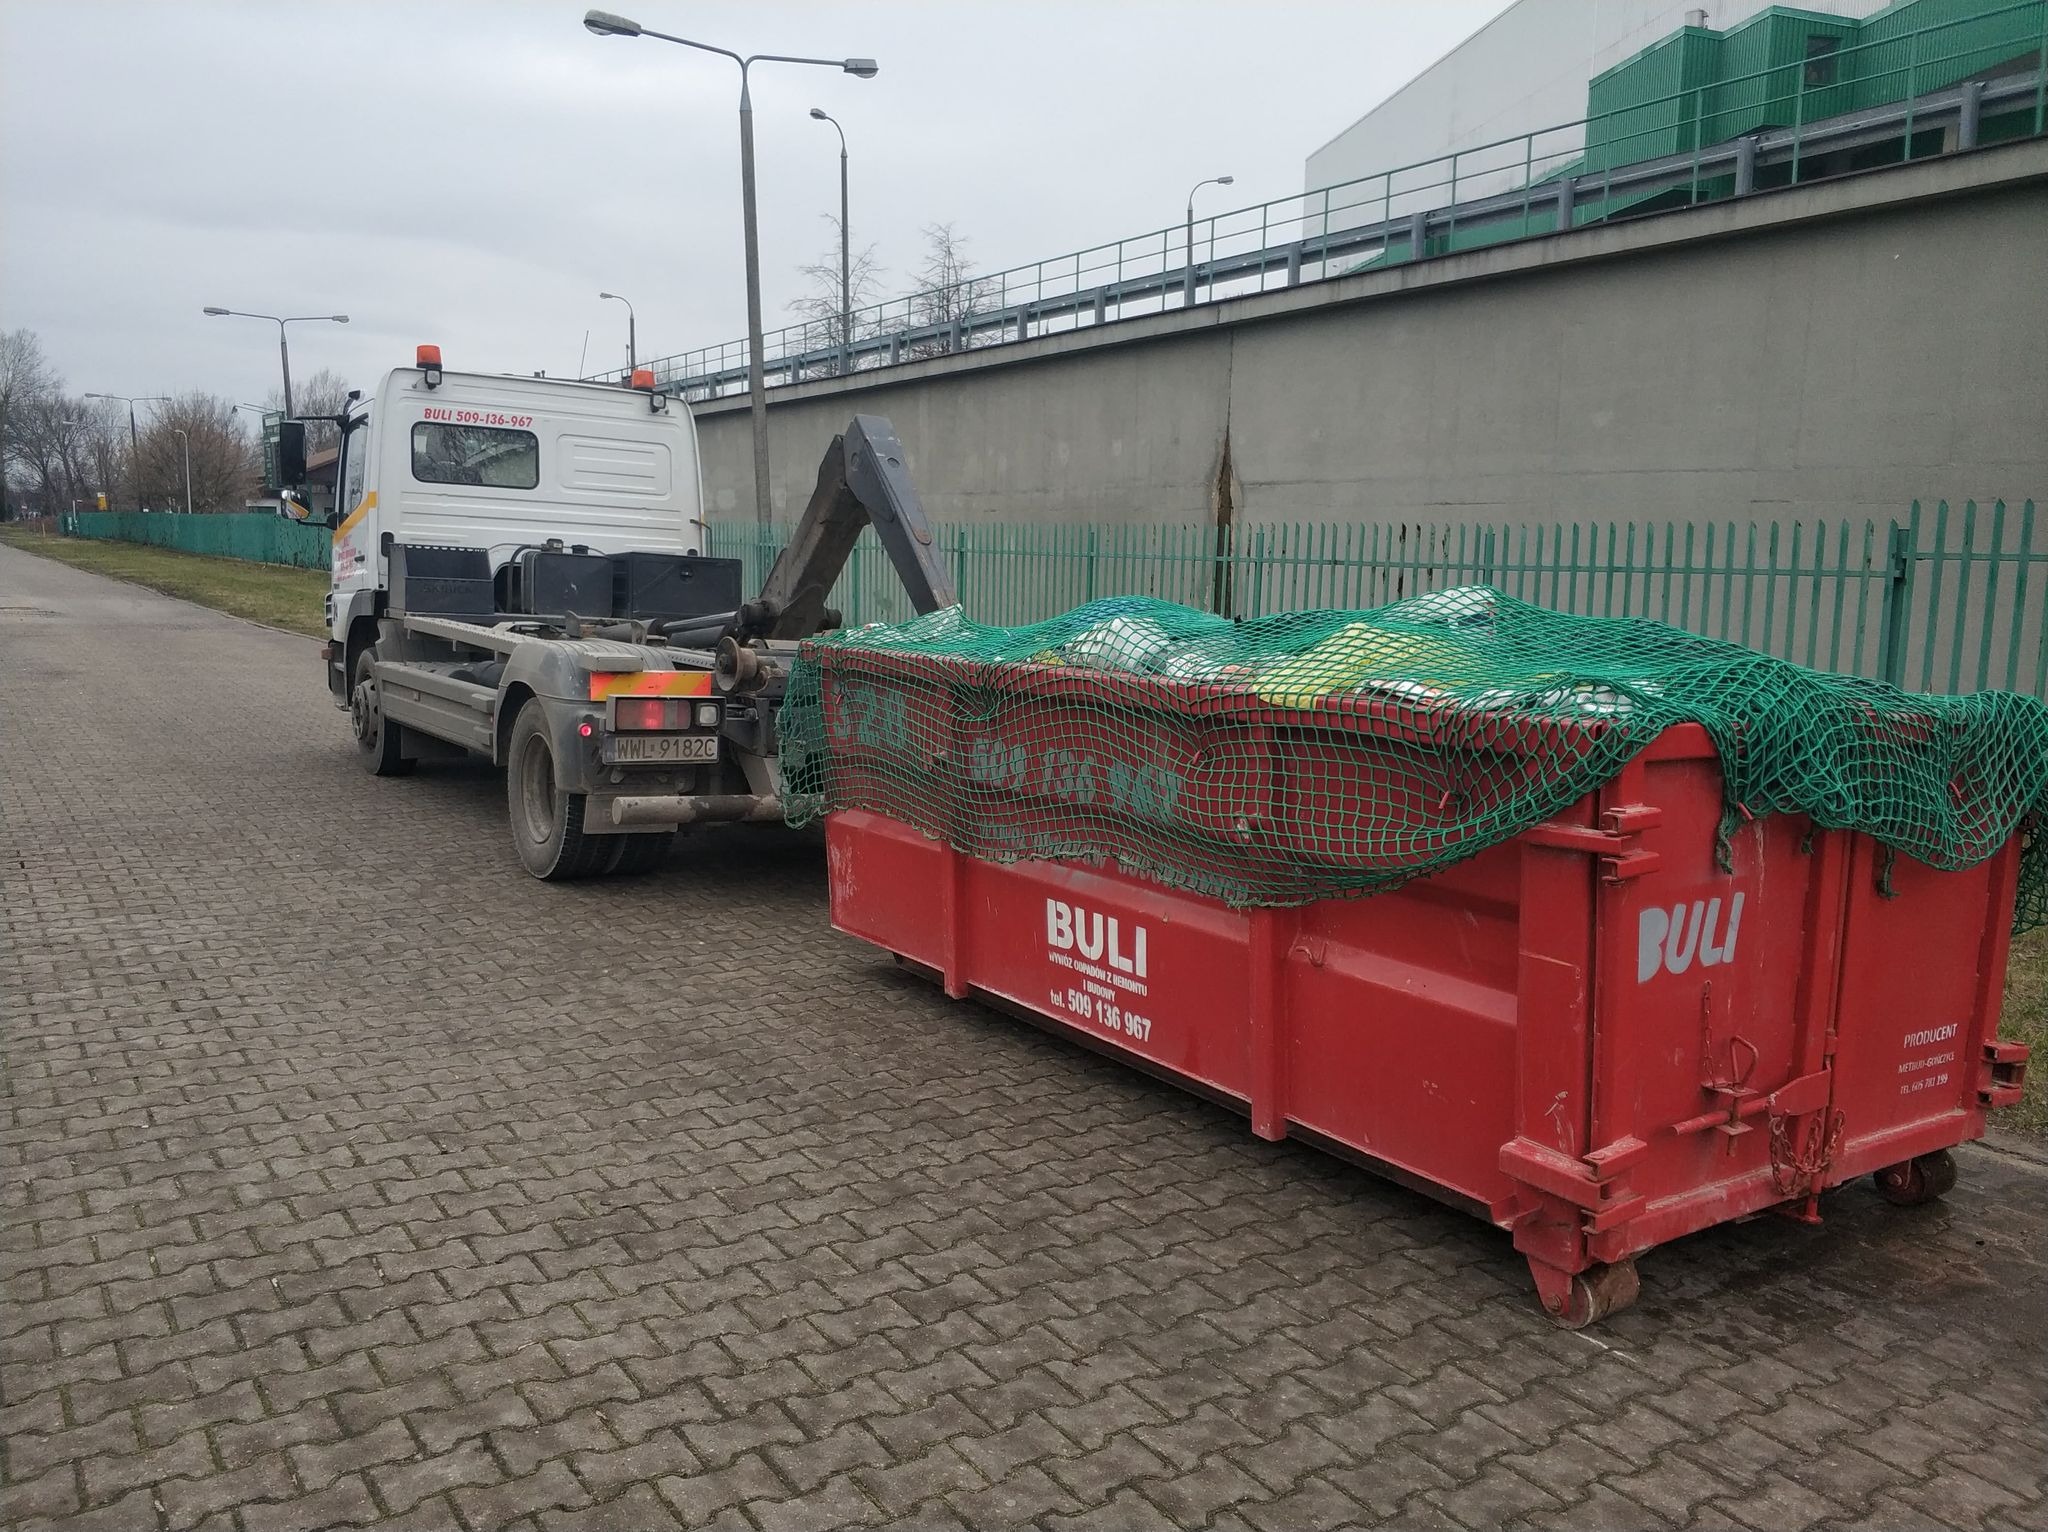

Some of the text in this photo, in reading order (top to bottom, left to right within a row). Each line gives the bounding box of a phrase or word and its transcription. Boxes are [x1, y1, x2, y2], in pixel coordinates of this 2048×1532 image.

[424, 408, 534, 427] BULI 509-136-967
[617, 739, 716, 759] WWL 9182C
[1047, 898, 1147, 978] BULI
[1638, 892, 1745, 984] BULI
[1048, 950, 1148, 997] WYWÓZ ODPADÓW Z REMONTU
[1082, 978, 1116, 1003] I BUDOWY
[1050, 987, 1152, 1043] tel. 509 136 967
[1903, 1023, 1958, 1049] PRODUCENT
